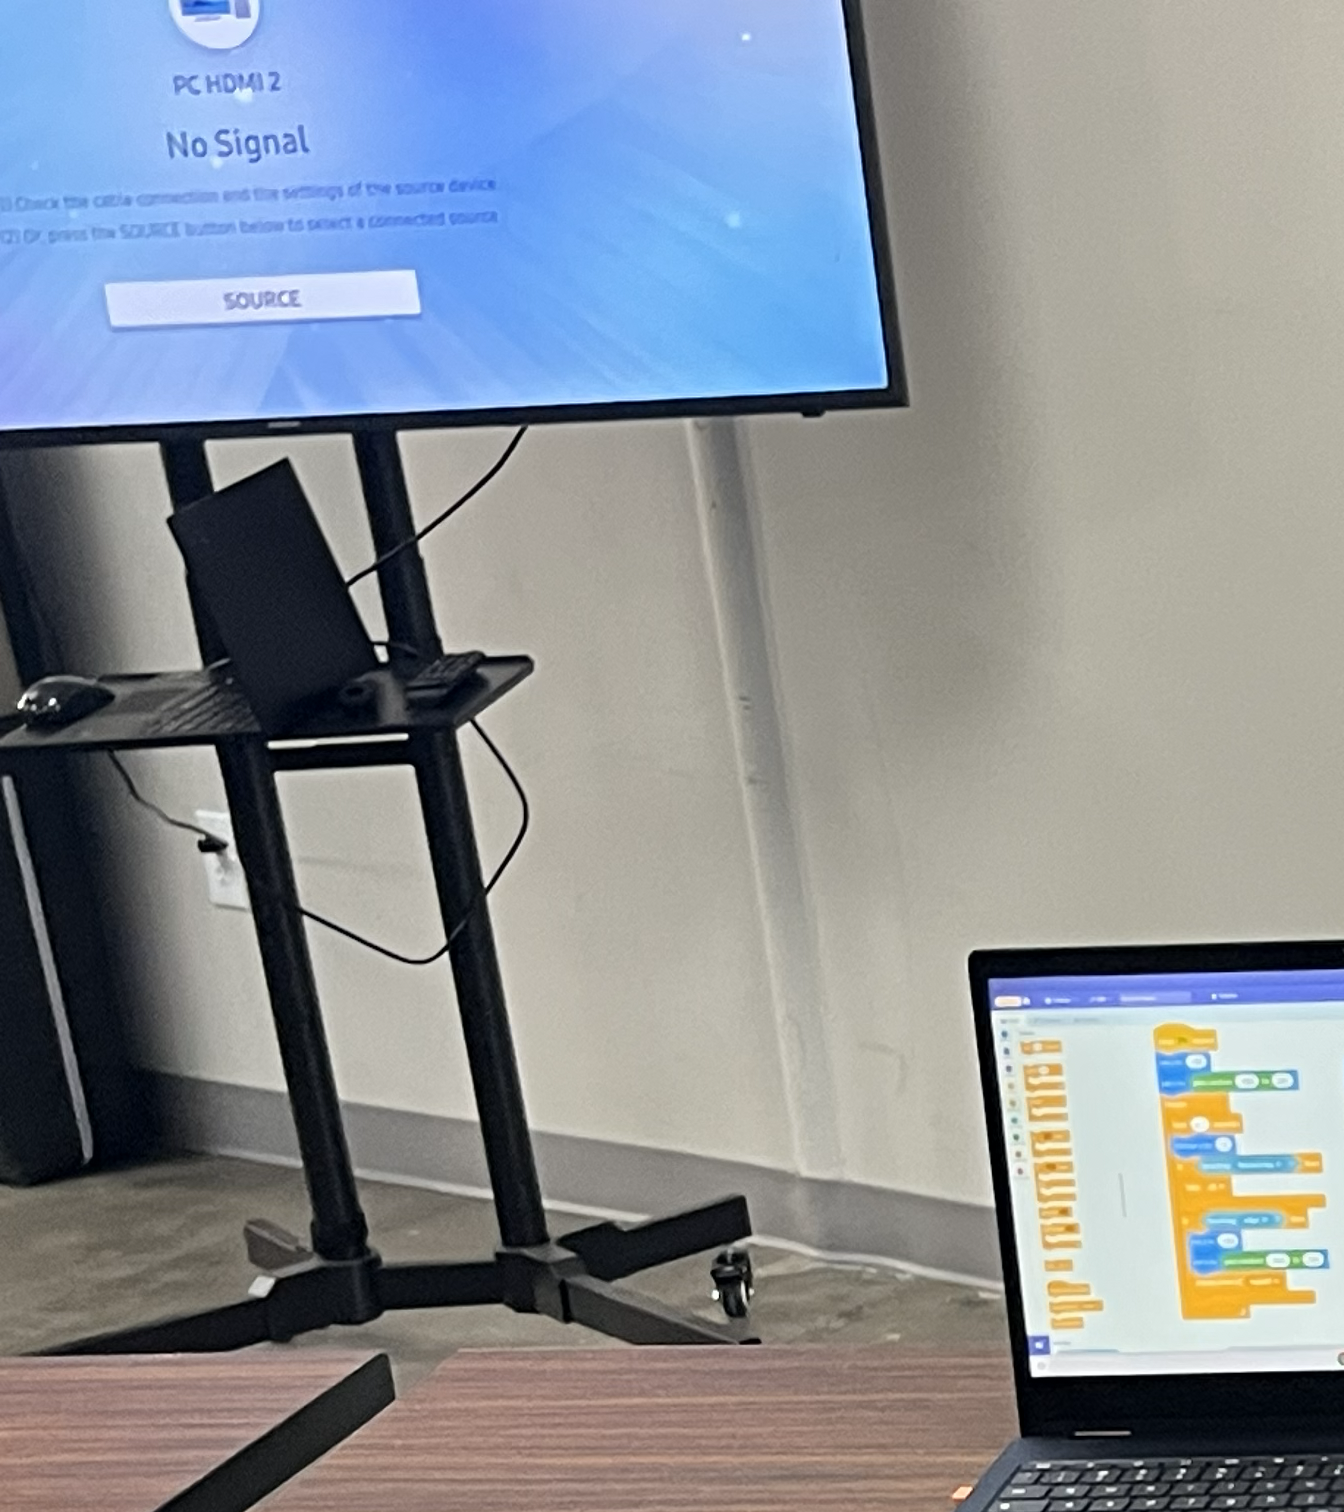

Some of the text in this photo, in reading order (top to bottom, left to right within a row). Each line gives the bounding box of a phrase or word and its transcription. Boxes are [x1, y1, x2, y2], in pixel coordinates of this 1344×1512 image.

[172, 71, 283, 95] PC HDMI 2
[166, 124, 311, 163] No Signal
[118, 222, 181, 239] SOURCE
[222, 289, 304, 311] SOURCE
